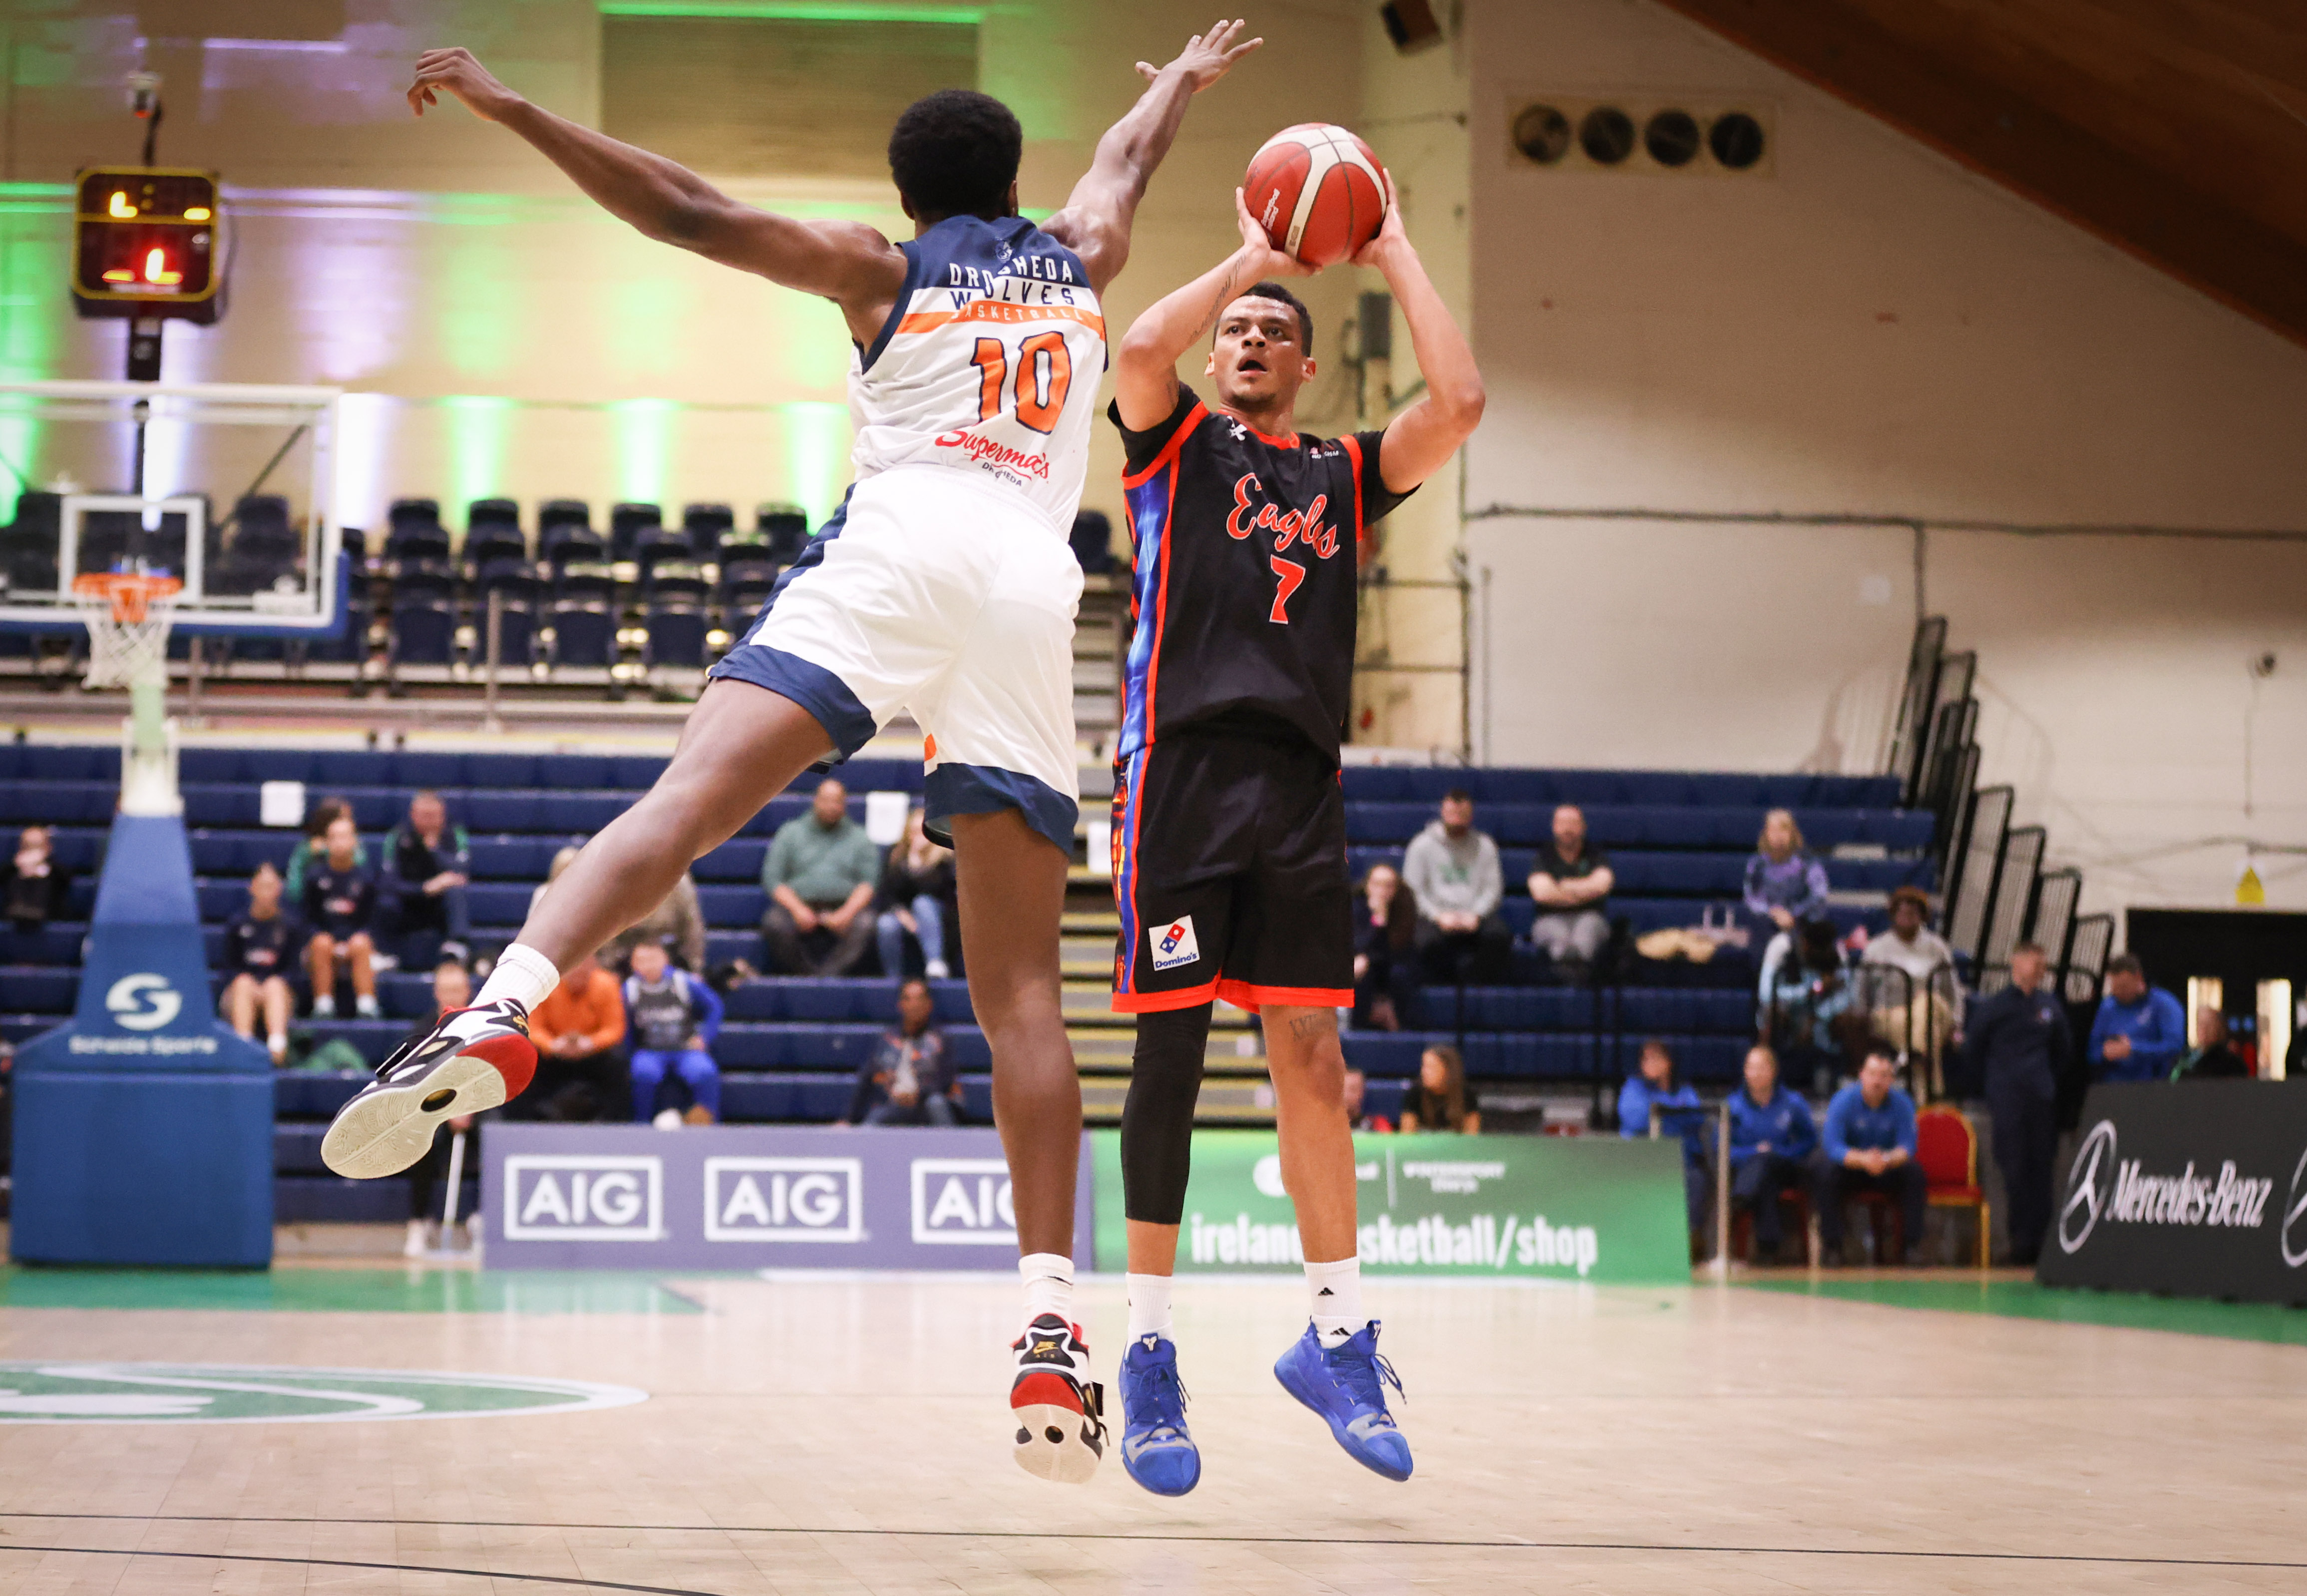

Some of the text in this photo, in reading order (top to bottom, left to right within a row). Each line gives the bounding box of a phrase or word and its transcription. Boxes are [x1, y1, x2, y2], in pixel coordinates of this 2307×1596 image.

[970, 331, 1072, 435] 10
[1269, 554, 1306, 625] 7
[1155, 952, 1197, 968] Domino's
[521, 1171, 643, 1226] AIG
[722, 1173, 842, 1227] AIG
